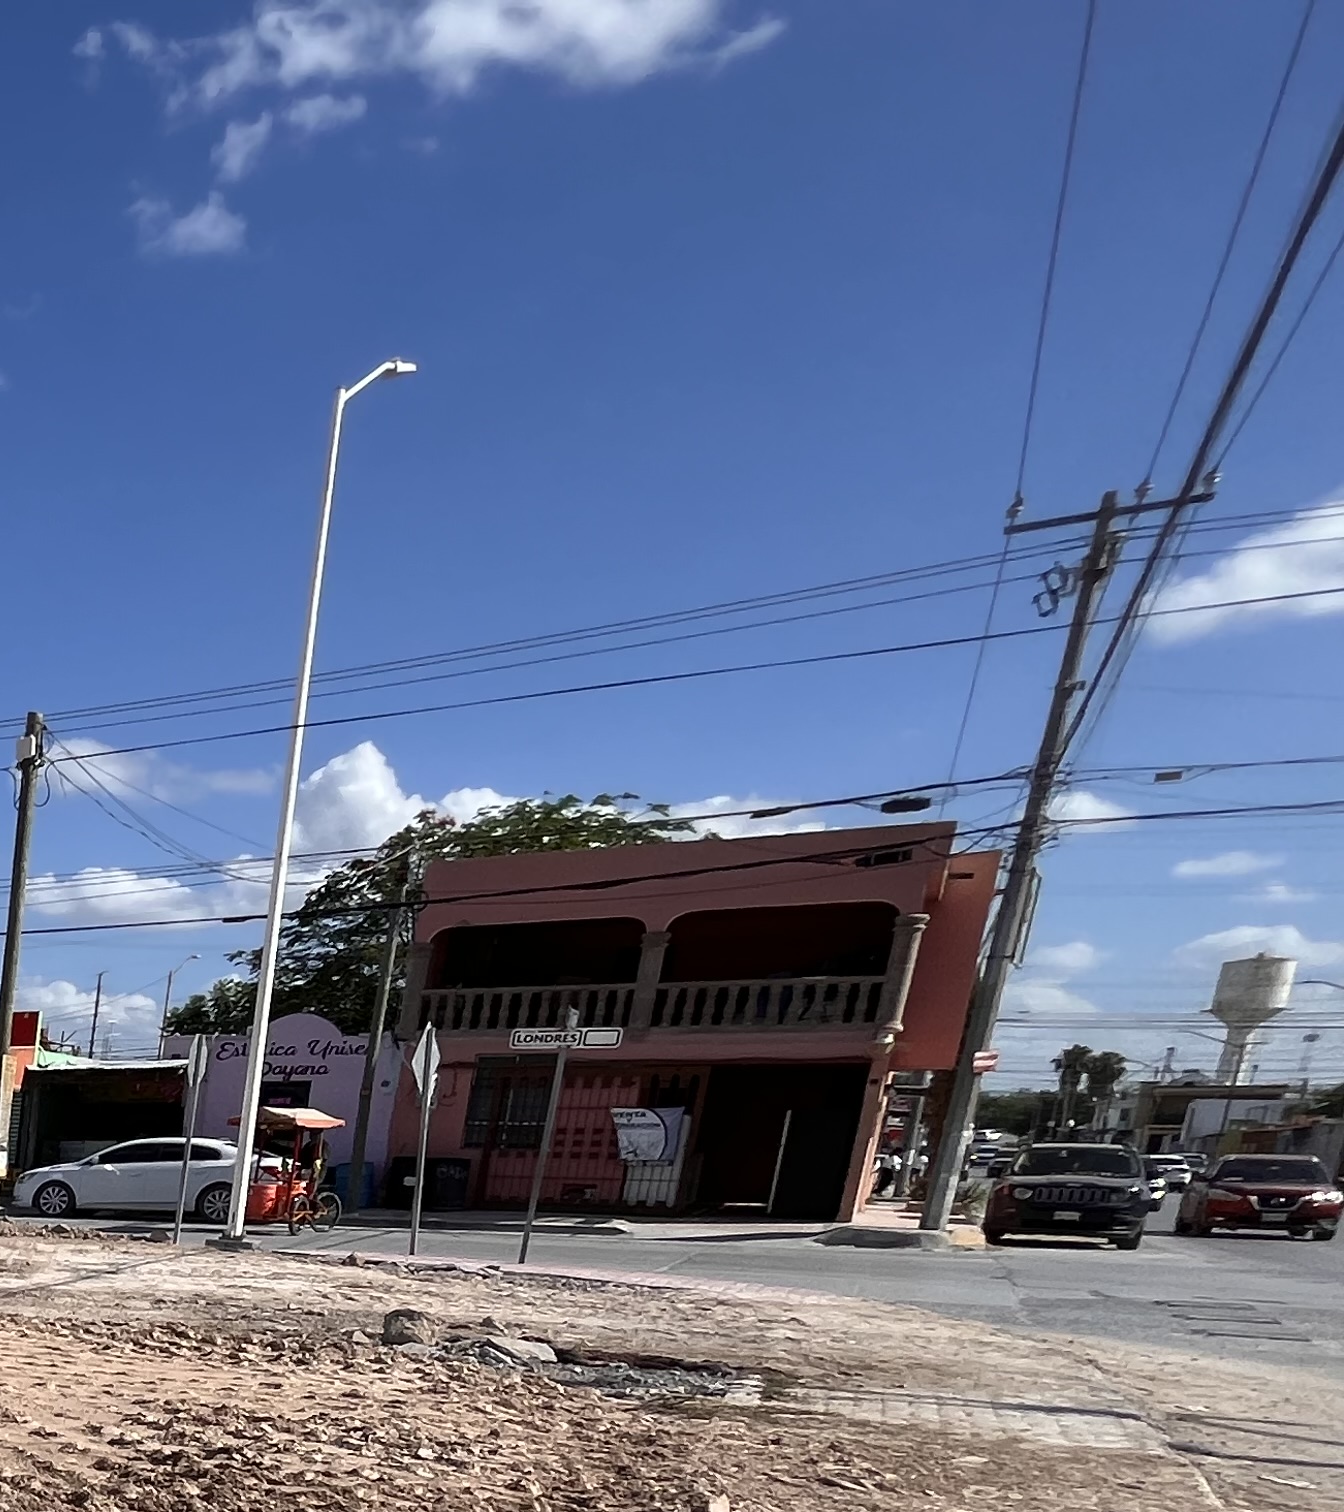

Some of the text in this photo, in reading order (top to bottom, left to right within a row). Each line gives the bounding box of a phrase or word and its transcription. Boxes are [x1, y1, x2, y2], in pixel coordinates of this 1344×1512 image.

[516, 1033, 578, 1044] LONDRES
[216, 1039, 369, 1061] Estica Unise
